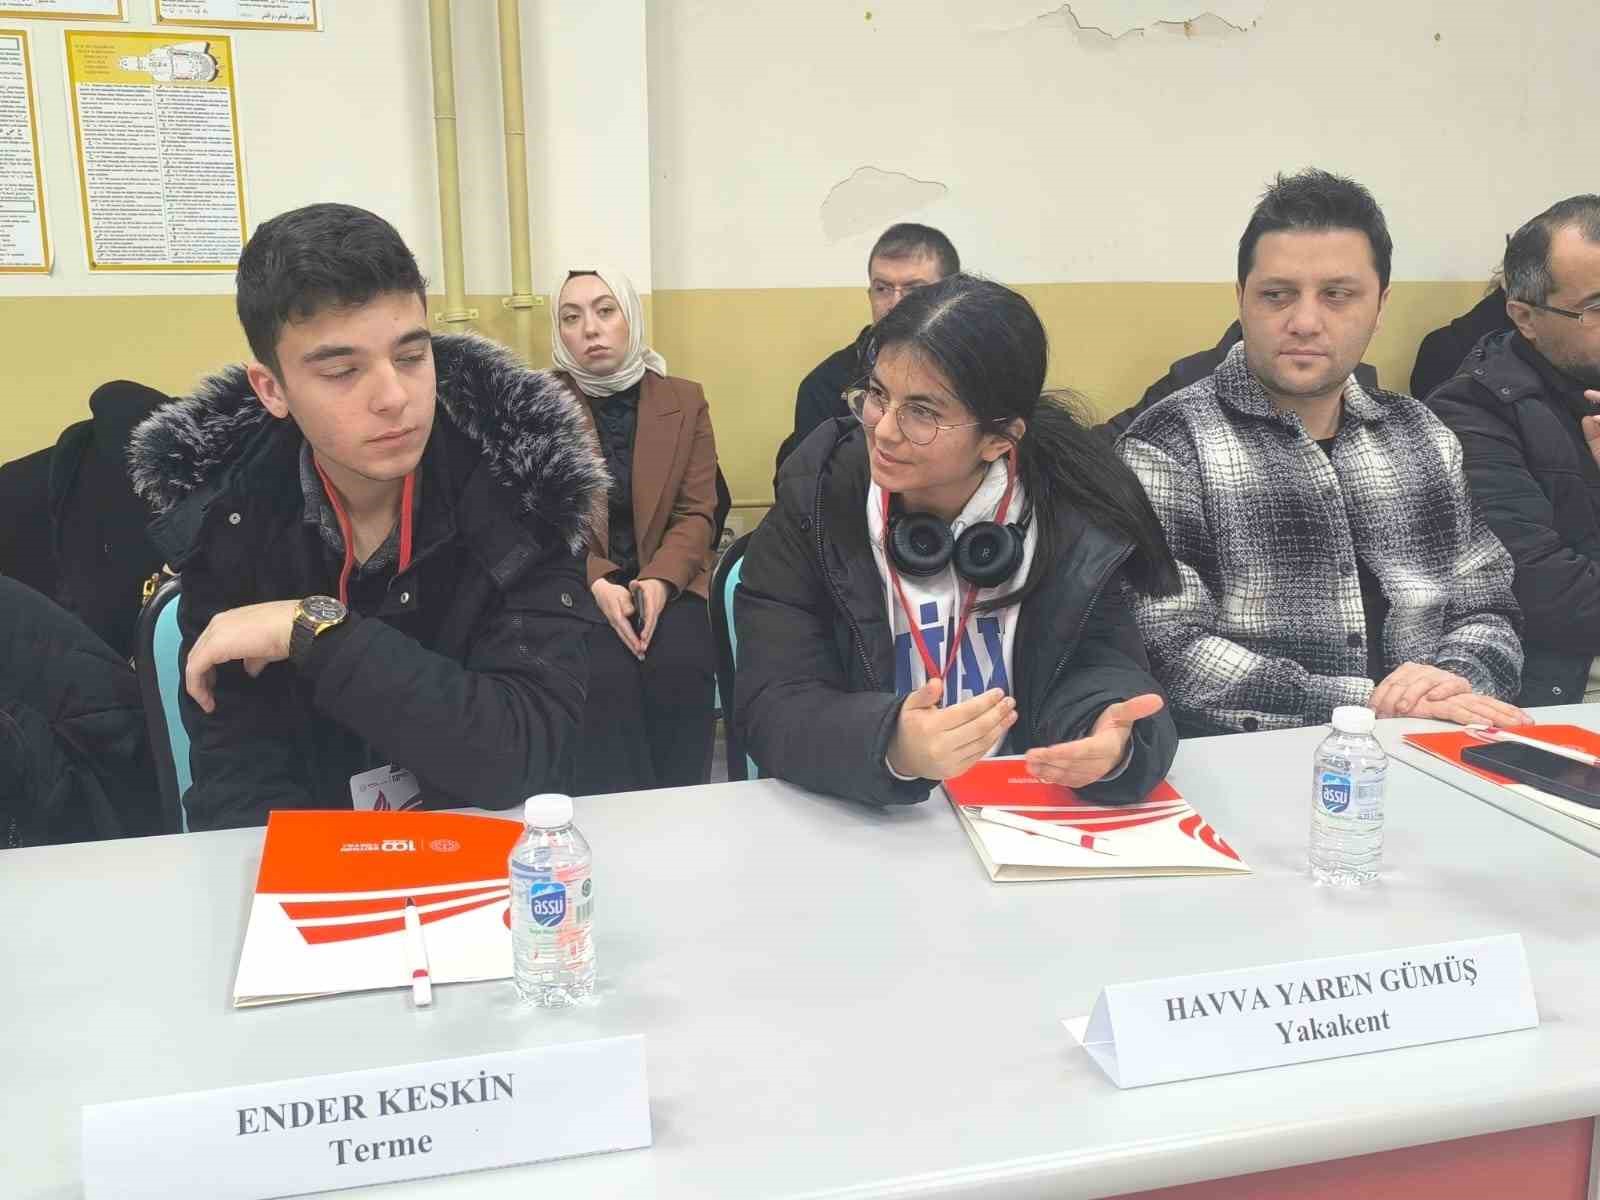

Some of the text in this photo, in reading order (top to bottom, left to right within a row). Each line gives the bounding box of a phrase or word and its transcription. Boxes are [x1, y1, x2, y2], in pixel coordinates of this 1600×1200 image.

[1166, 955, 1478, 1021] HAVVA YAREN GÜMÜŞ
[1275, 1009, 1391, 1045] Yakakent
[237, 1070, 515, 1136] ENDER KESKİN
[329, 1133, 433, 1167] Terme
